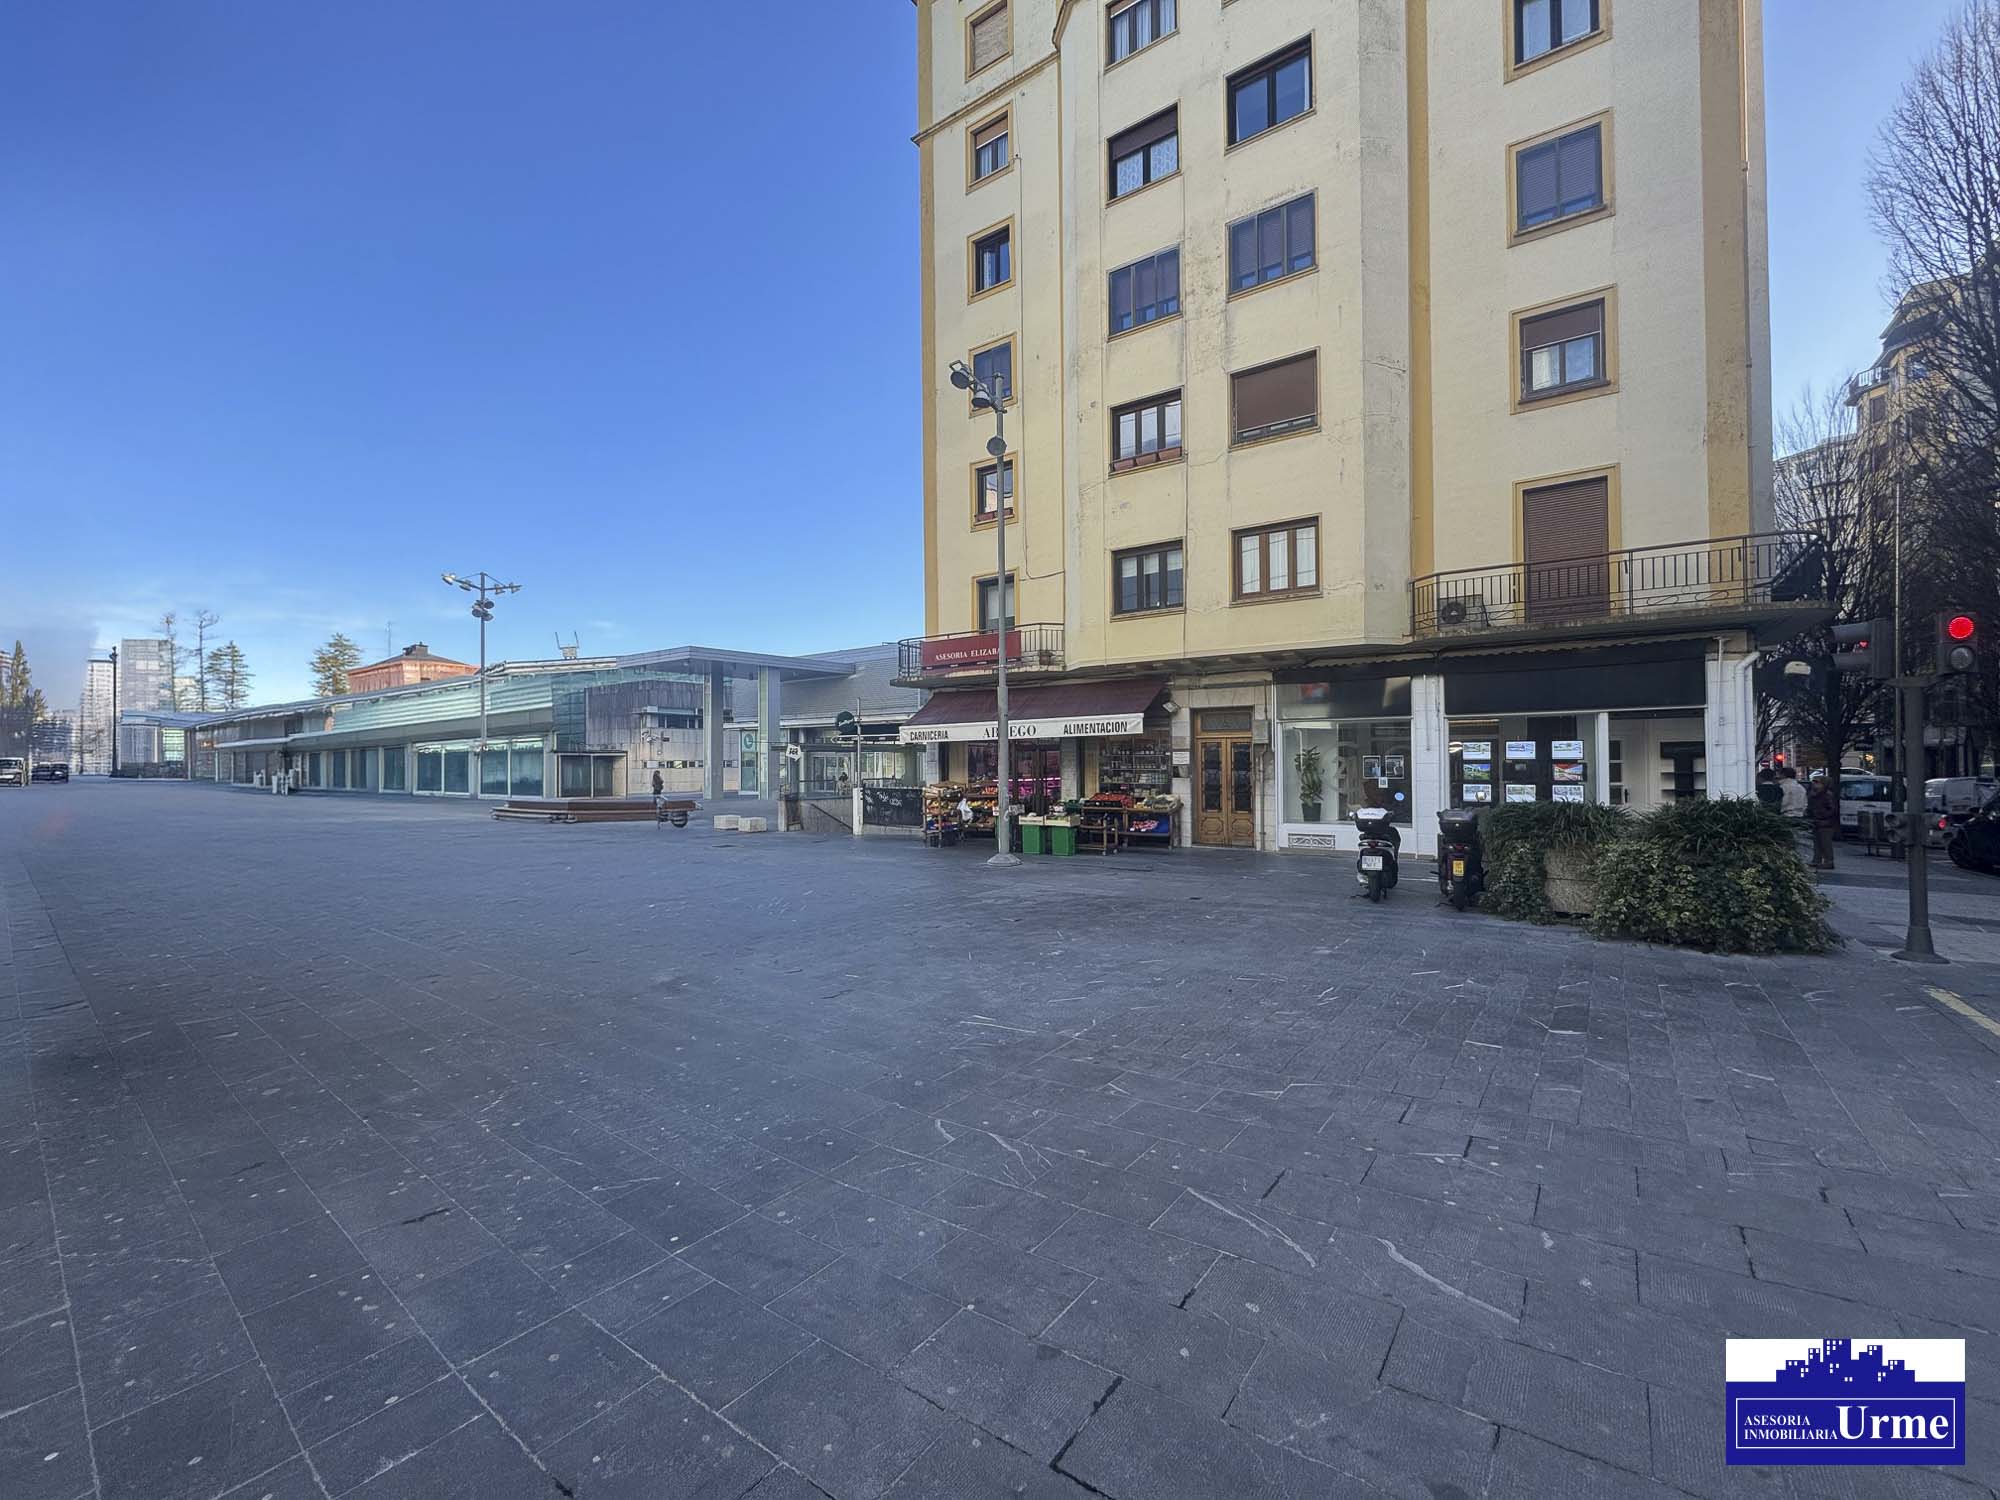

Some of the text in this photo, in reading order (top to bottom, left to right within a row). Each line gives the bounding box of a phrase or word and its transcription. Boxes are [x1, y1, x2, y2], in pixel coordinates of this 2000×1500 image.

[935, 650, 968, 661] ASESORIA
[910, 721, 1128, 741] CARNICERIA ABEGO ALIMENTACION
